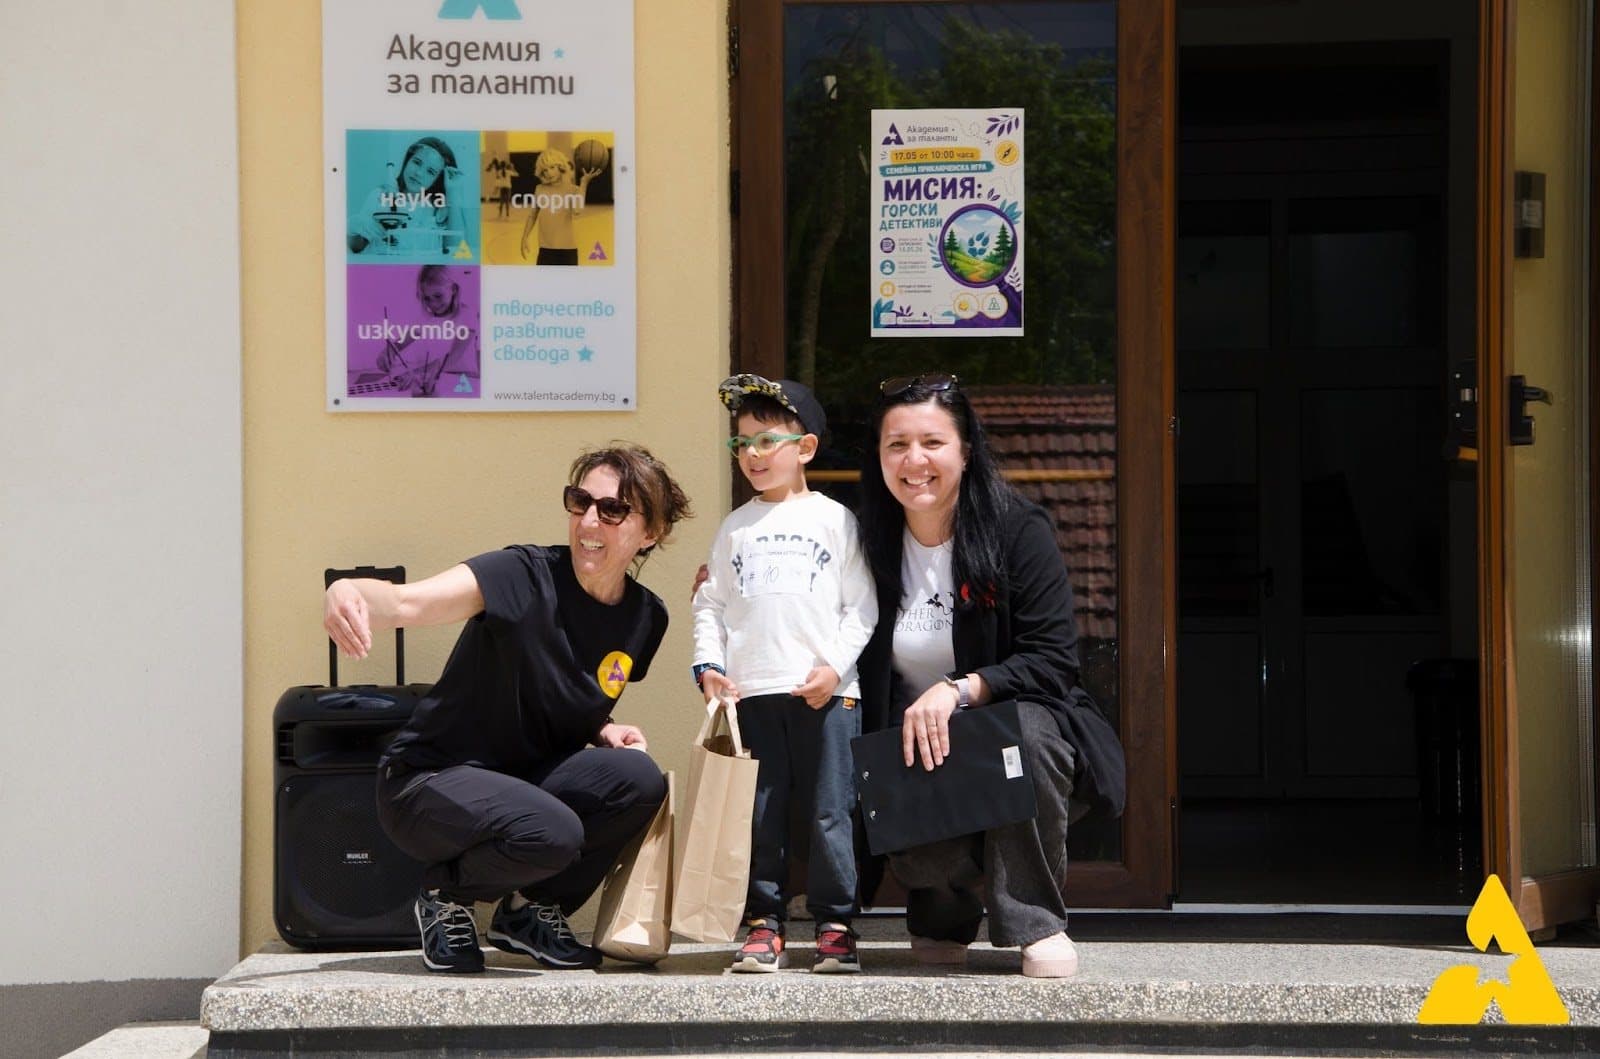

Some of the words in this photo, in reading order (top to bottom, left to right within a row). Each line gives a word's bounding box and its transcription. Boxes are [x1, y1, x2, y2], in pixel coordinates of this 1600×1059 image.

[386, 34, 540, 66] Академия
[386, 73, 420, 95] за
[431, 73, 575, 96] таланти
[907, 125, 949, 134] Академия
[894, 151, 917, 161] 17.05
[931, 150, 955, 159] 10:00
[883, 176, 982, 202] МИСИЯ:
[380, 188, 447, 213] наука
[511, 190, 585, 214] спорт
[881, 202, 938, 218] ГОРСКИ
[879, 217, 943, 231] ДЕТЕКТИВИ
[493, 300, 615, 320] творчество
[358, 319, 470, 343] изкуство
[493, 322, 586, 343] развитие
[493, 345, 570, 365] свобода
[494, 389, 616, 403] www.talentacademy.bg
